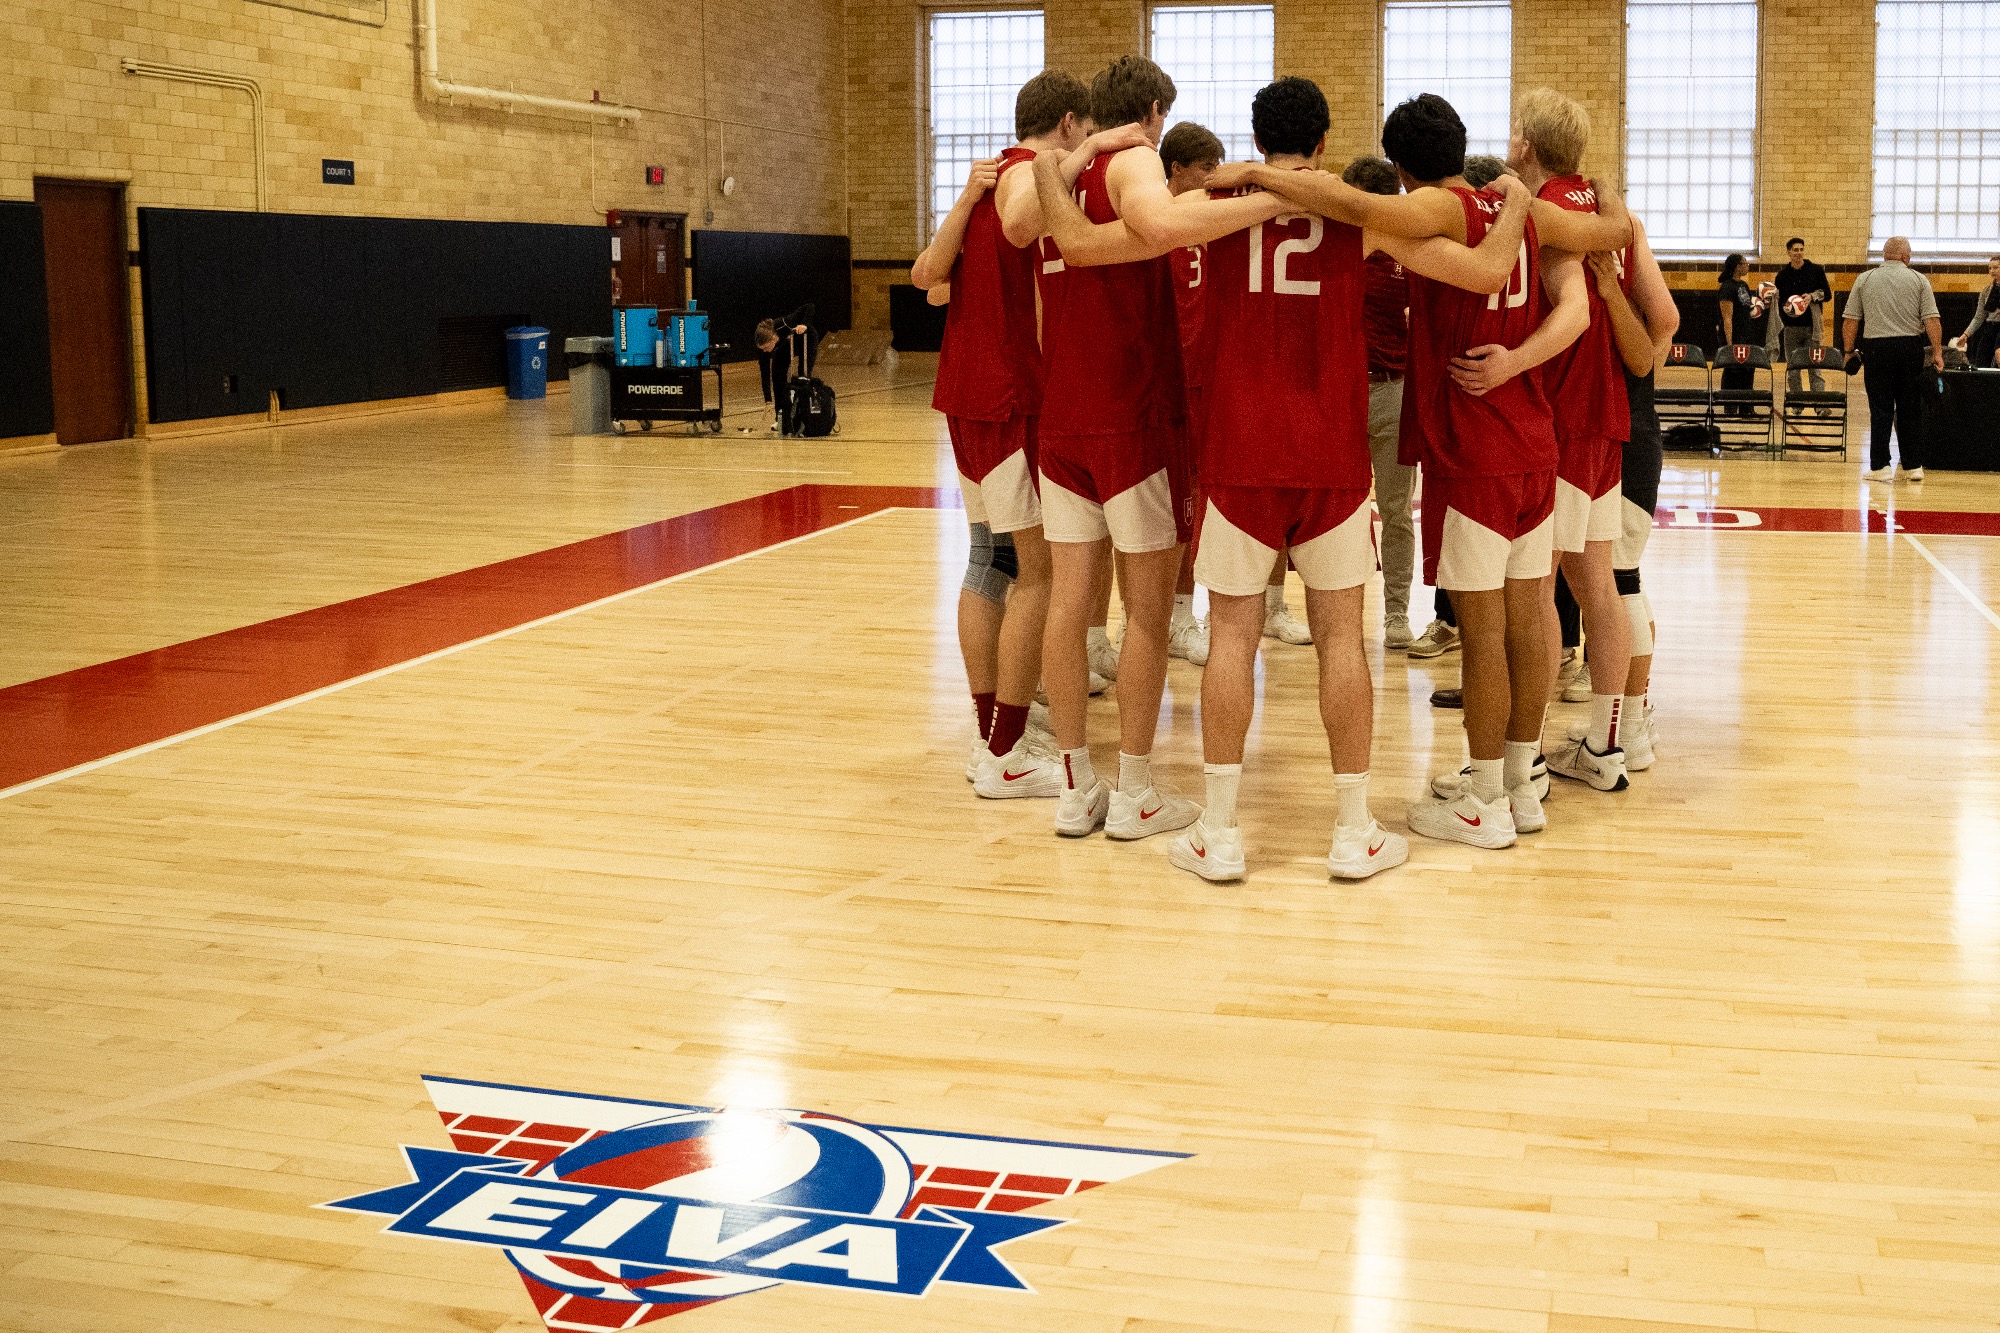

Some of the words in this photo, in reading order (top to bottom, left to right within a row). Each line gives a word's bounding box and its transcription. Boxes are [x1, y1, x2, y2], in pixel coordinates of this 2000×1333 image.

[326, 167, 346, 175] COURT
[1248, 211, 1324, 296] 12
[627, 384, 684, 395] POWERADE
[426, 1181, 899, 1284] EIVA
